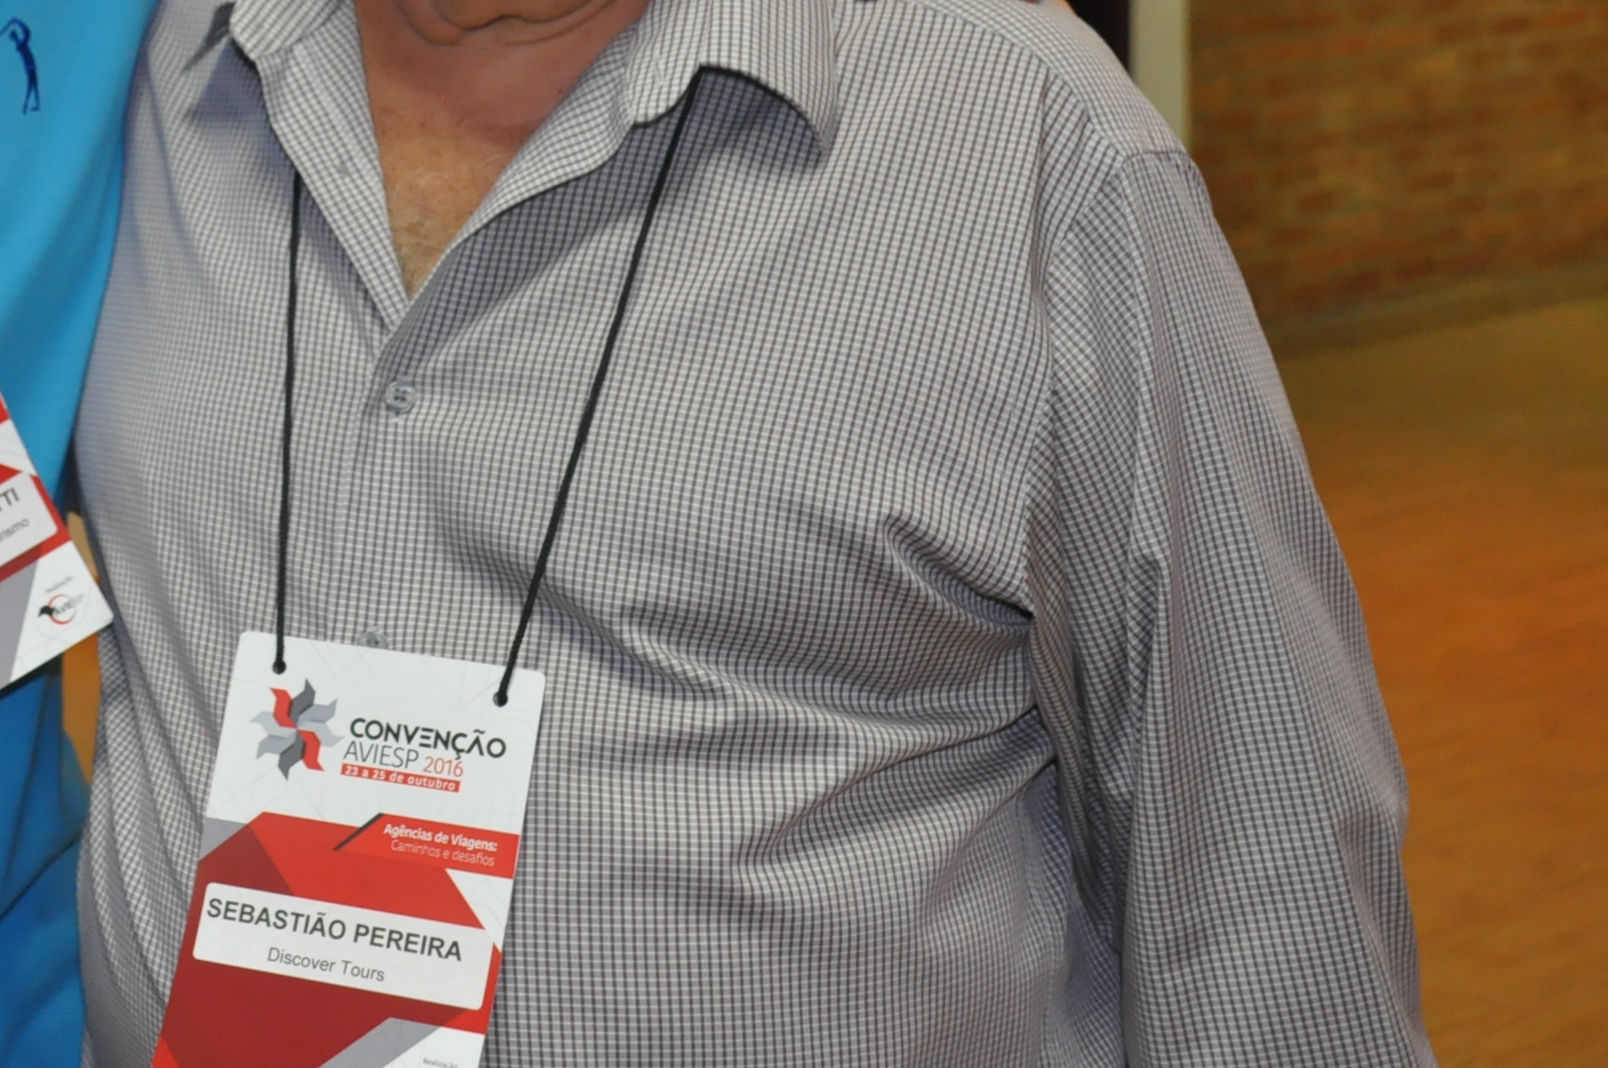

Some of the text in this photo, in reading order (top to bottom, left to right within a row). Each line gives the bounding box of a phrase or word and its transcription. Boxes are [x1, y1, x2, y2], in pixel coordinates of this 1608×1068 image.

[350, 717, 507, 761] CONVENÇÃO
[343, 740, 464, 778] AVIESP 2016
[345, 765, 456, 791] 23 a 25 de outubro
[383, 823, 498, 852] Agências de Viagens:
[391, 839, 495, 867] Caminhos e desafios
[206, 898, 462, 962] SEBASTIÃO PEREIRA
[267, 946, 385, 982] Discover Tours
